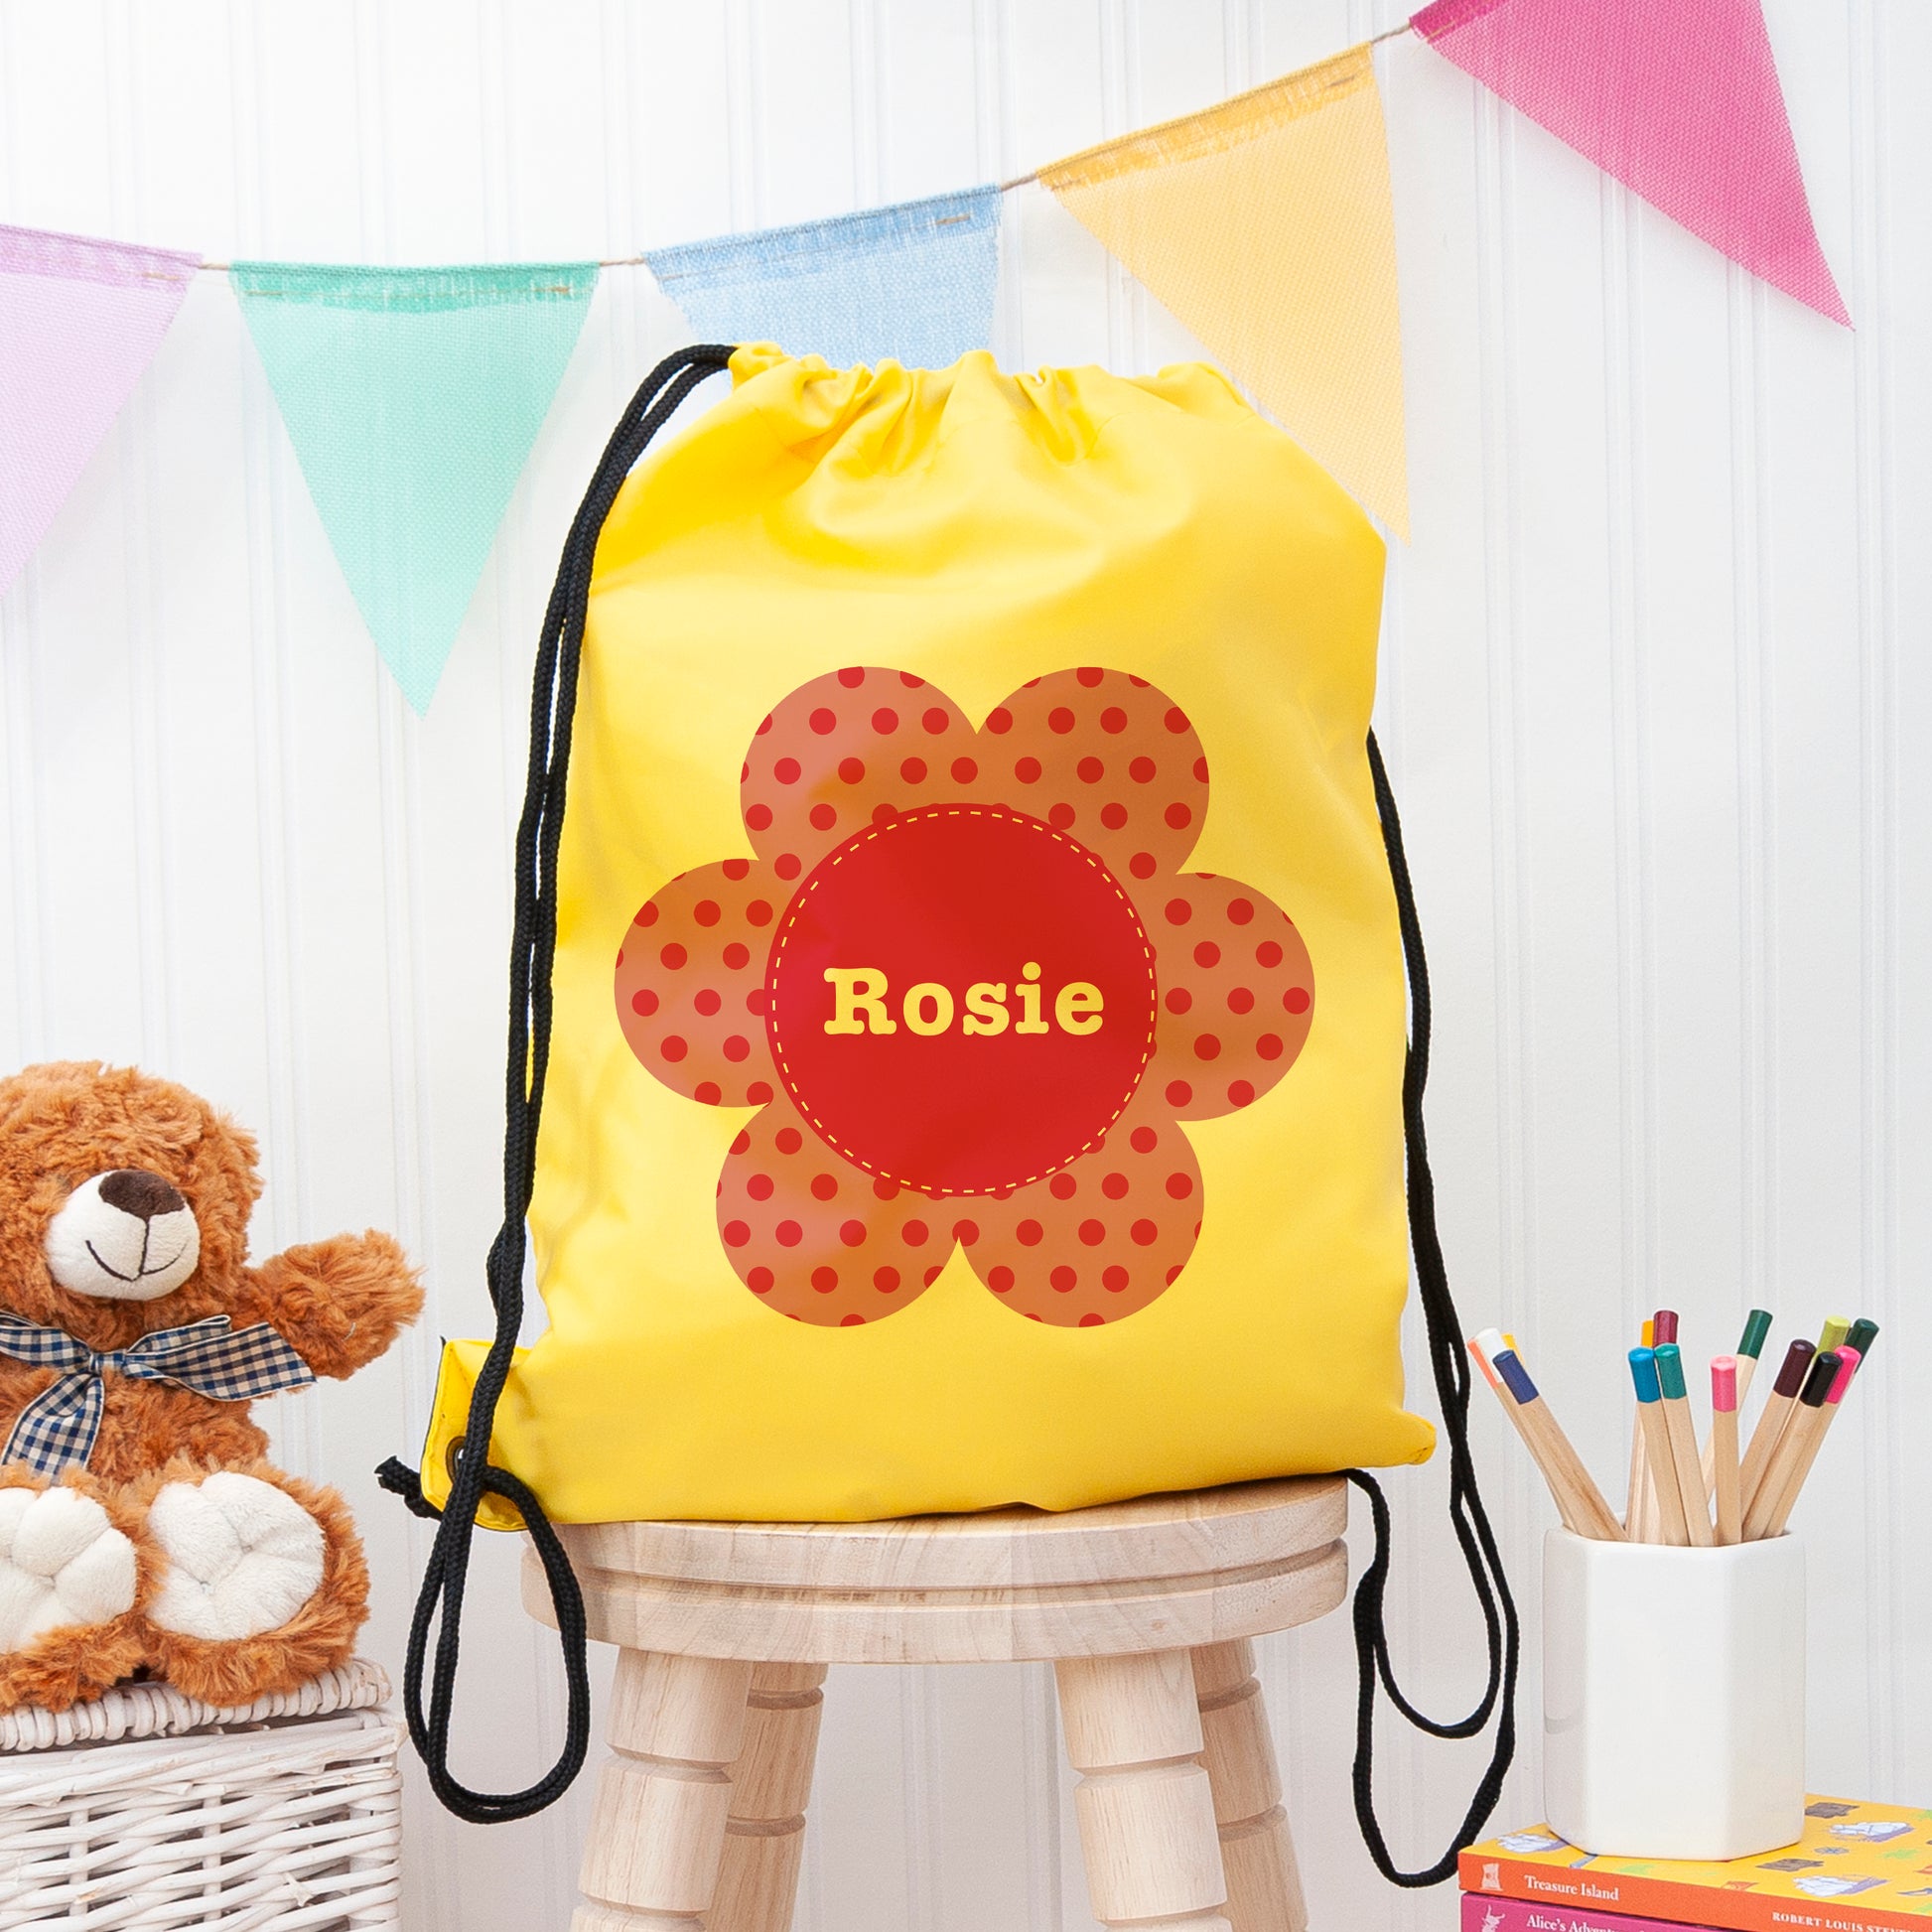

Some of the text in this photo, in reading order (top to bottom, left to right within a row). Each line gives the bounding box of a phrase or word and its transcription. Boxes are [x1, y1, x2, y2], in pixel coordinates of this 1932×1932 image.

[823, 961, 1105, 1036] Rosie
[1524, 1874, 1619, 1901] Treasure Island
[1526, 1914, 1567, 1932] Alice's
[1771, 1911, 1823, 1927] ROBERT
[1825, 1918, 1863, 1932] LOUIS
